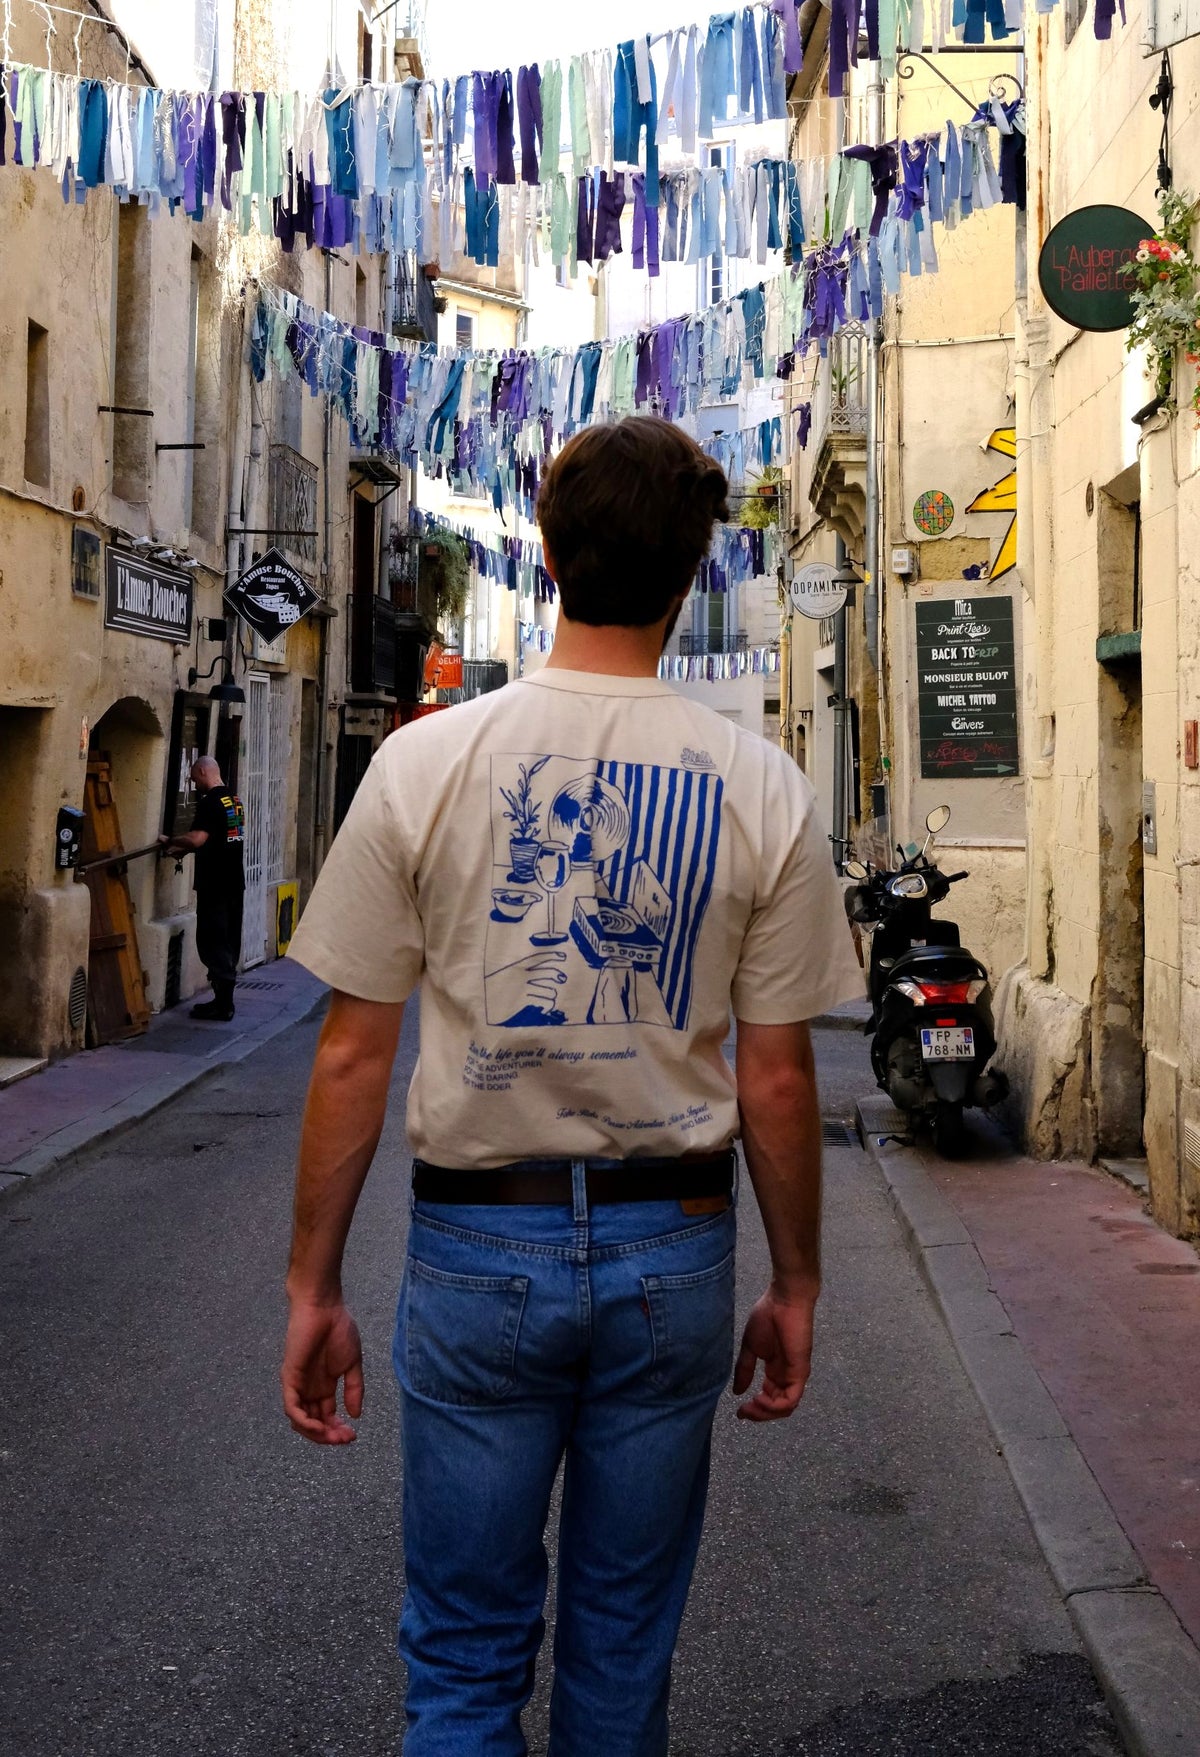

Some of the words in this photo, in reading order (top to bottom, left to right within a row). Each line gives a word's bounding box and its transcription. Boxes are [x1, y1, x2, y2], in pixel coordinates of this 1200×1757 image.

[237, 565, 273, 593] L'Amuse
[274, 564, 307, 598] Bouches
[117, 566, 151, 615] L'Amuse
[152, 579, 188, 626] Bouches
[937, 623, 966, 636] Print
[964, 622, 991, 637] Tee's
[438, 657, 461, 665] DELHI
[931, 647, 957, 661] BACK
[961, 646, 975, 659] TO
[974, 646, 999, 658] FRIP
[924, 673, 974, 684] MONSIEUR
[975, 671, 1009, 681] BULOT
[937, 695, 966, 707] MICHEL
[969, 693, 997, 706] TATTOO
[495, 1048, 512, 1063] life
[512, 1046, 546, 1061] you'll
[547, 1048, 585, 1064] always
[927, 1044, 971, 1056] 768-NM
